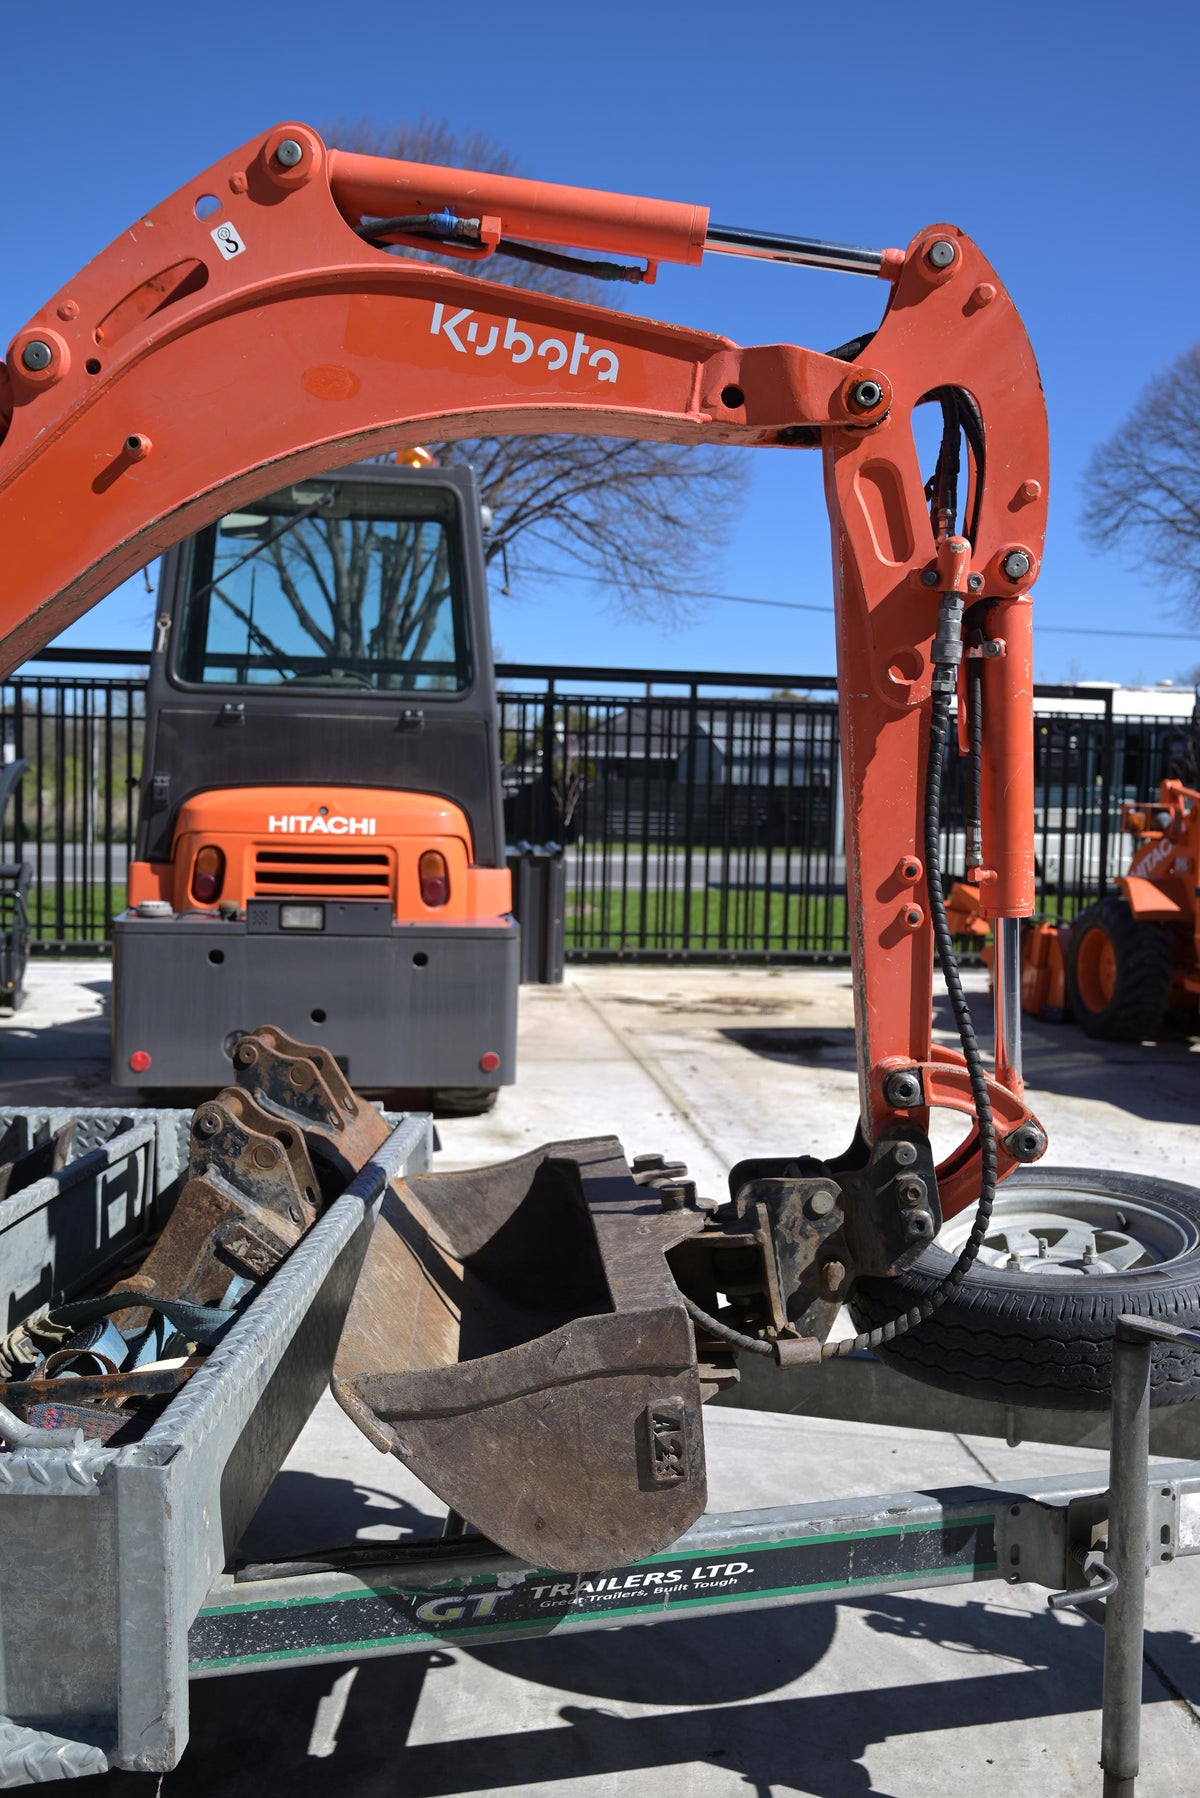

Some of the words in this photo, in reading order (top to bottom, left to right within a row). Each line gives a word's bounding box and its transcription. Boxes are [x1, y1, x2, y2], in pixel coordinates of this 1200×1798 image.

[430, 302, 620, 383] Kubota
[268, 815, 376, 835] HITACHI
[1129, 837, 1173, 879] HITAC
[415, 1589, 514, 1622] GT
[530, 1569, 683, 1599] TRAILERS
[691, 1562, 755, 1580] LTD.
[539, 1597, 583, 1608] Great
[587, 1589, 648, 1602] Trailers,
[653, 1583, 689, 1594] Built
[693, 1577, 738, 1589] Tough
